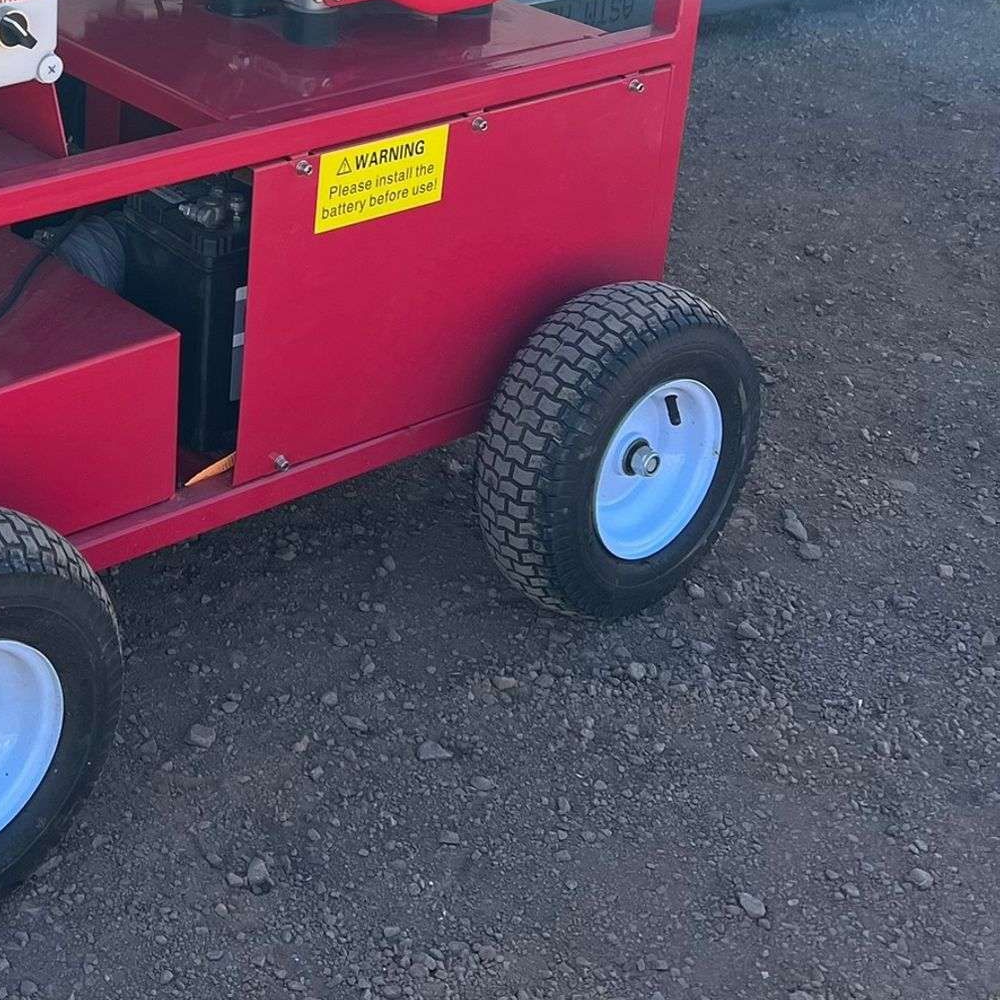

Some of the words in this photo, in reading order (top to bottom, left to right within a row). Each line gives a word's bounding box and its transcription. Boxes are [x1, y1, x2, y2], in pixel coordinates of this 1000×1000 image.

[355, 140, 426, 170] WARNING
[321, 198, 367, 220] battery
[368, 187, 409, 208] before
[411, 177, 438, 196] use!
[329, 179, 372, 200] Please
[375, 166, 413, 188] install
[415, 163, 435, 178] the
